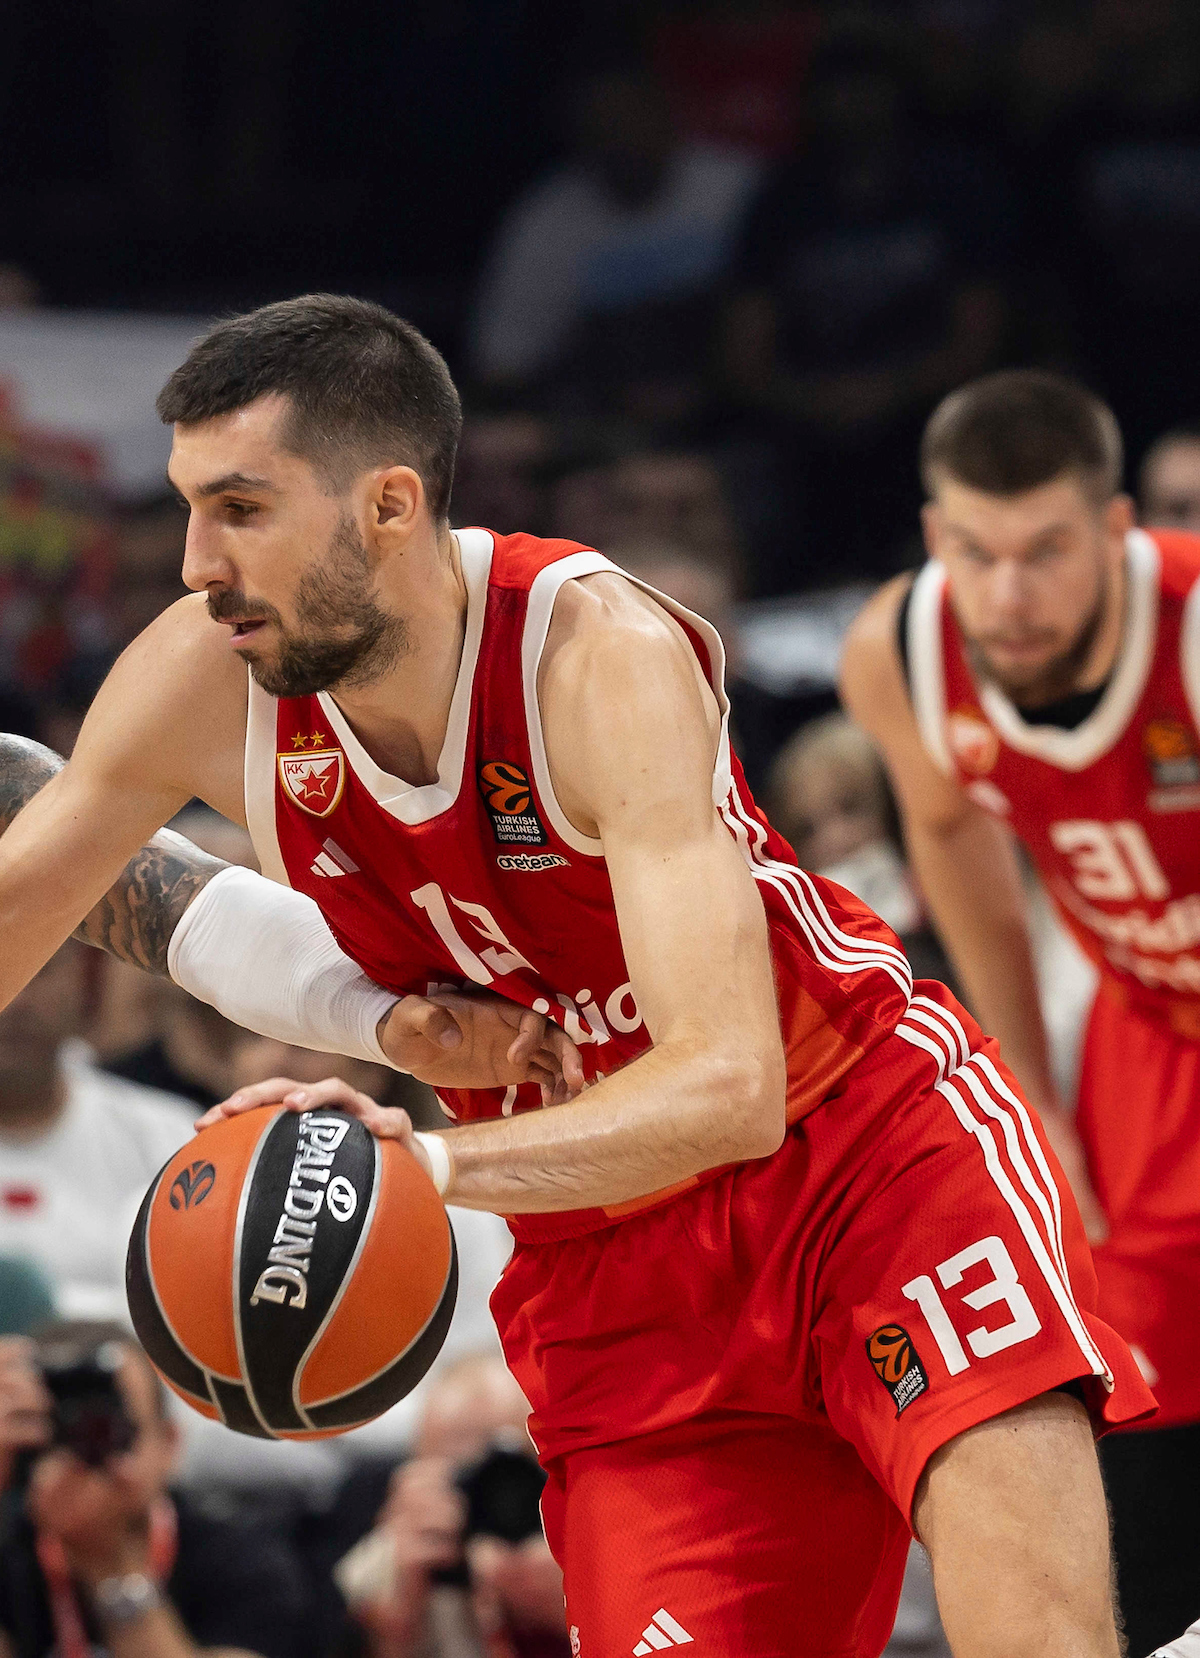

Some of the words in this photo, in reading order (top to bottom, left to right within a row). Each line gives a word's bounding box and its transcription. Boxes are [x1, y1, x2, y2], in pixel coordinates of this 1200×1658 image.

[286, 763, 305, 775] KK
[492, 815, 538, 826] TURKISH
[496, 824, 540, 835] AIRLINES
[1050, 820, 1171, 900] 31
[409, 881, 540, 986] 13
[250, 1112, 350, 1309] PALDING
[901, 1235, 1042, 1377] 13
[893, 1365, 920, 1400] TURKISH
